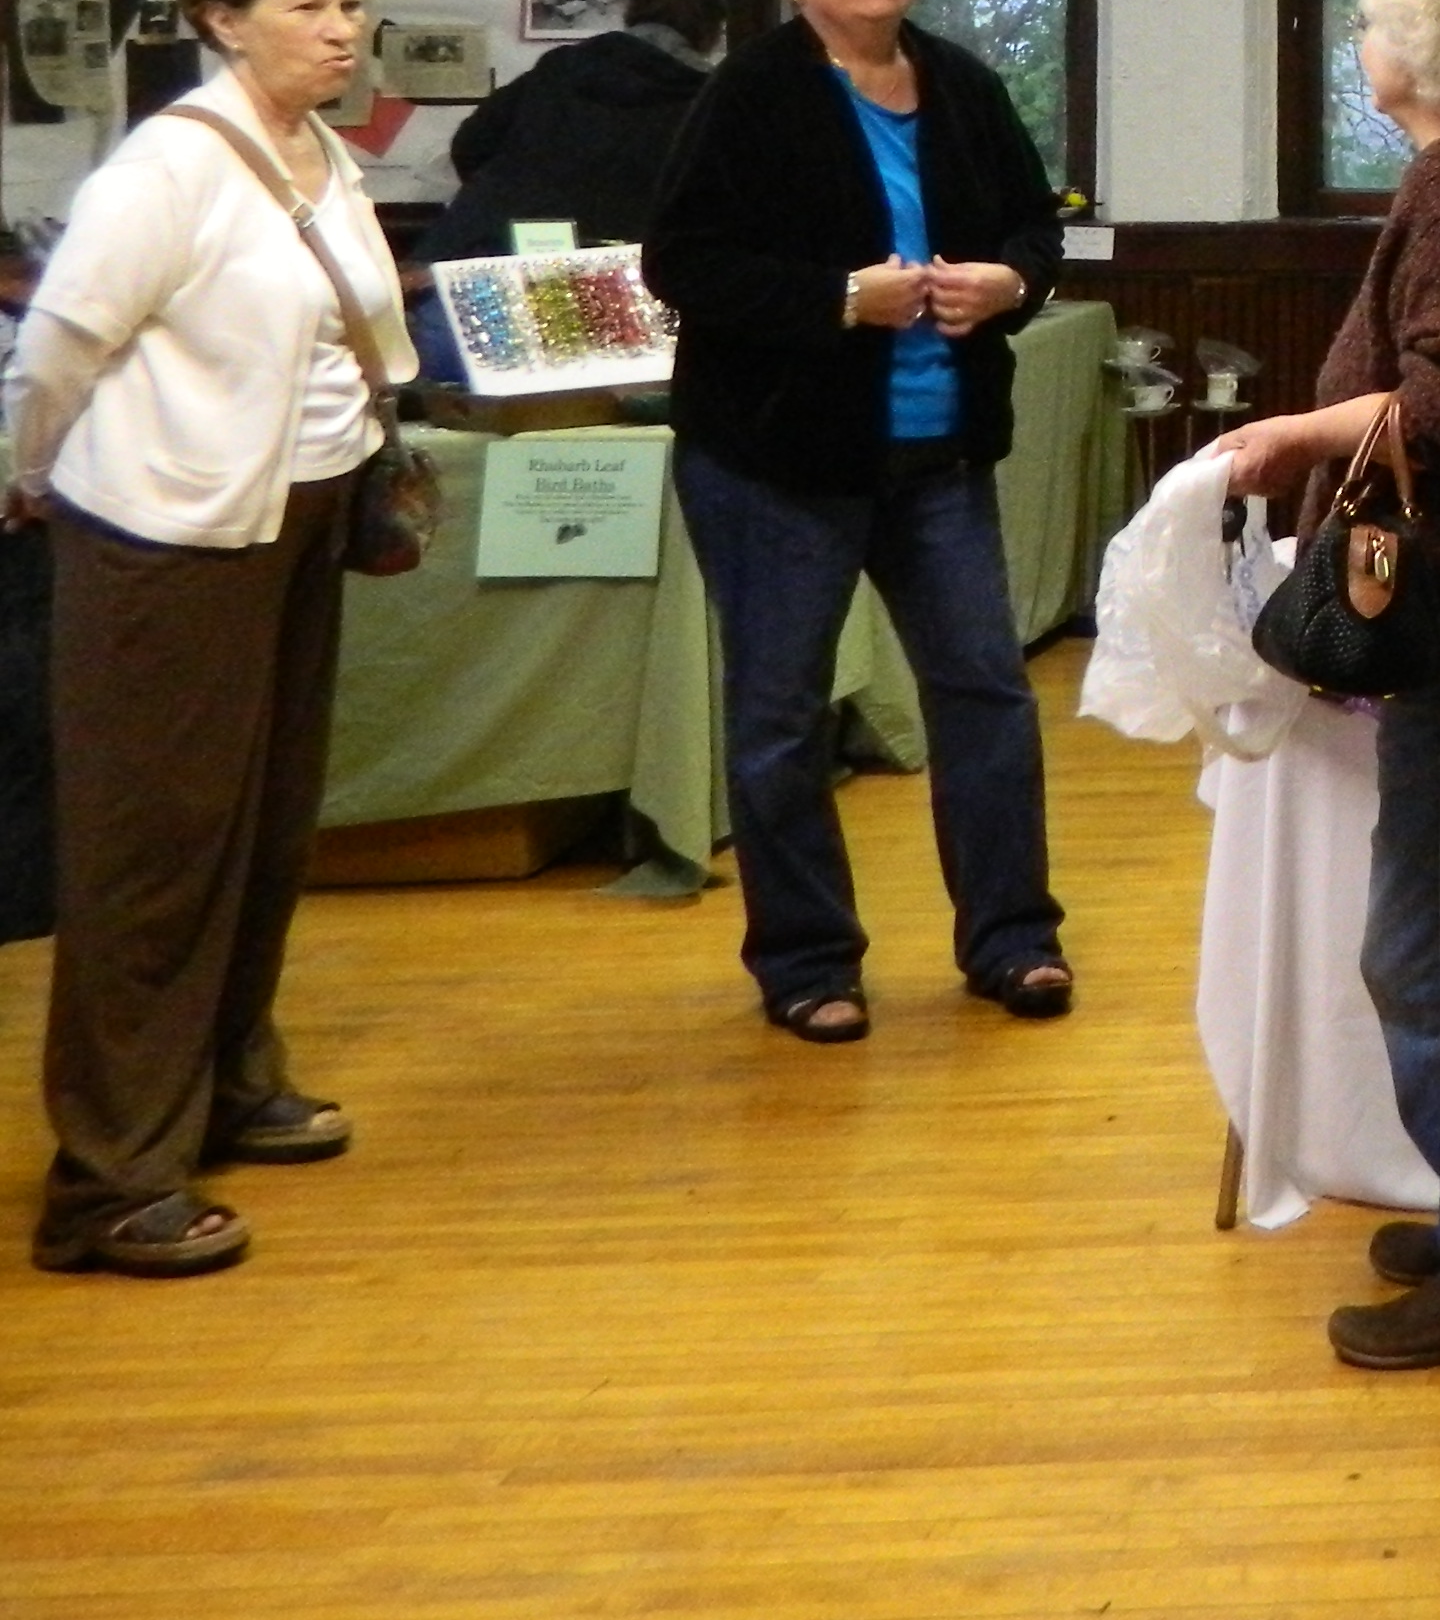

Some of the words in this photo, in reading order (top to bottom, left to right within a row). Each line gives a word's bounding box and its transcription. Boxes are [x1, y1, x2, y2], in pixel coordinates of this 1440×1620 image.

[528, 459, 591, 473] Rhubarb
[594, 459, 626, 473] Leaf
[535, 477, 567, 493] Bird
